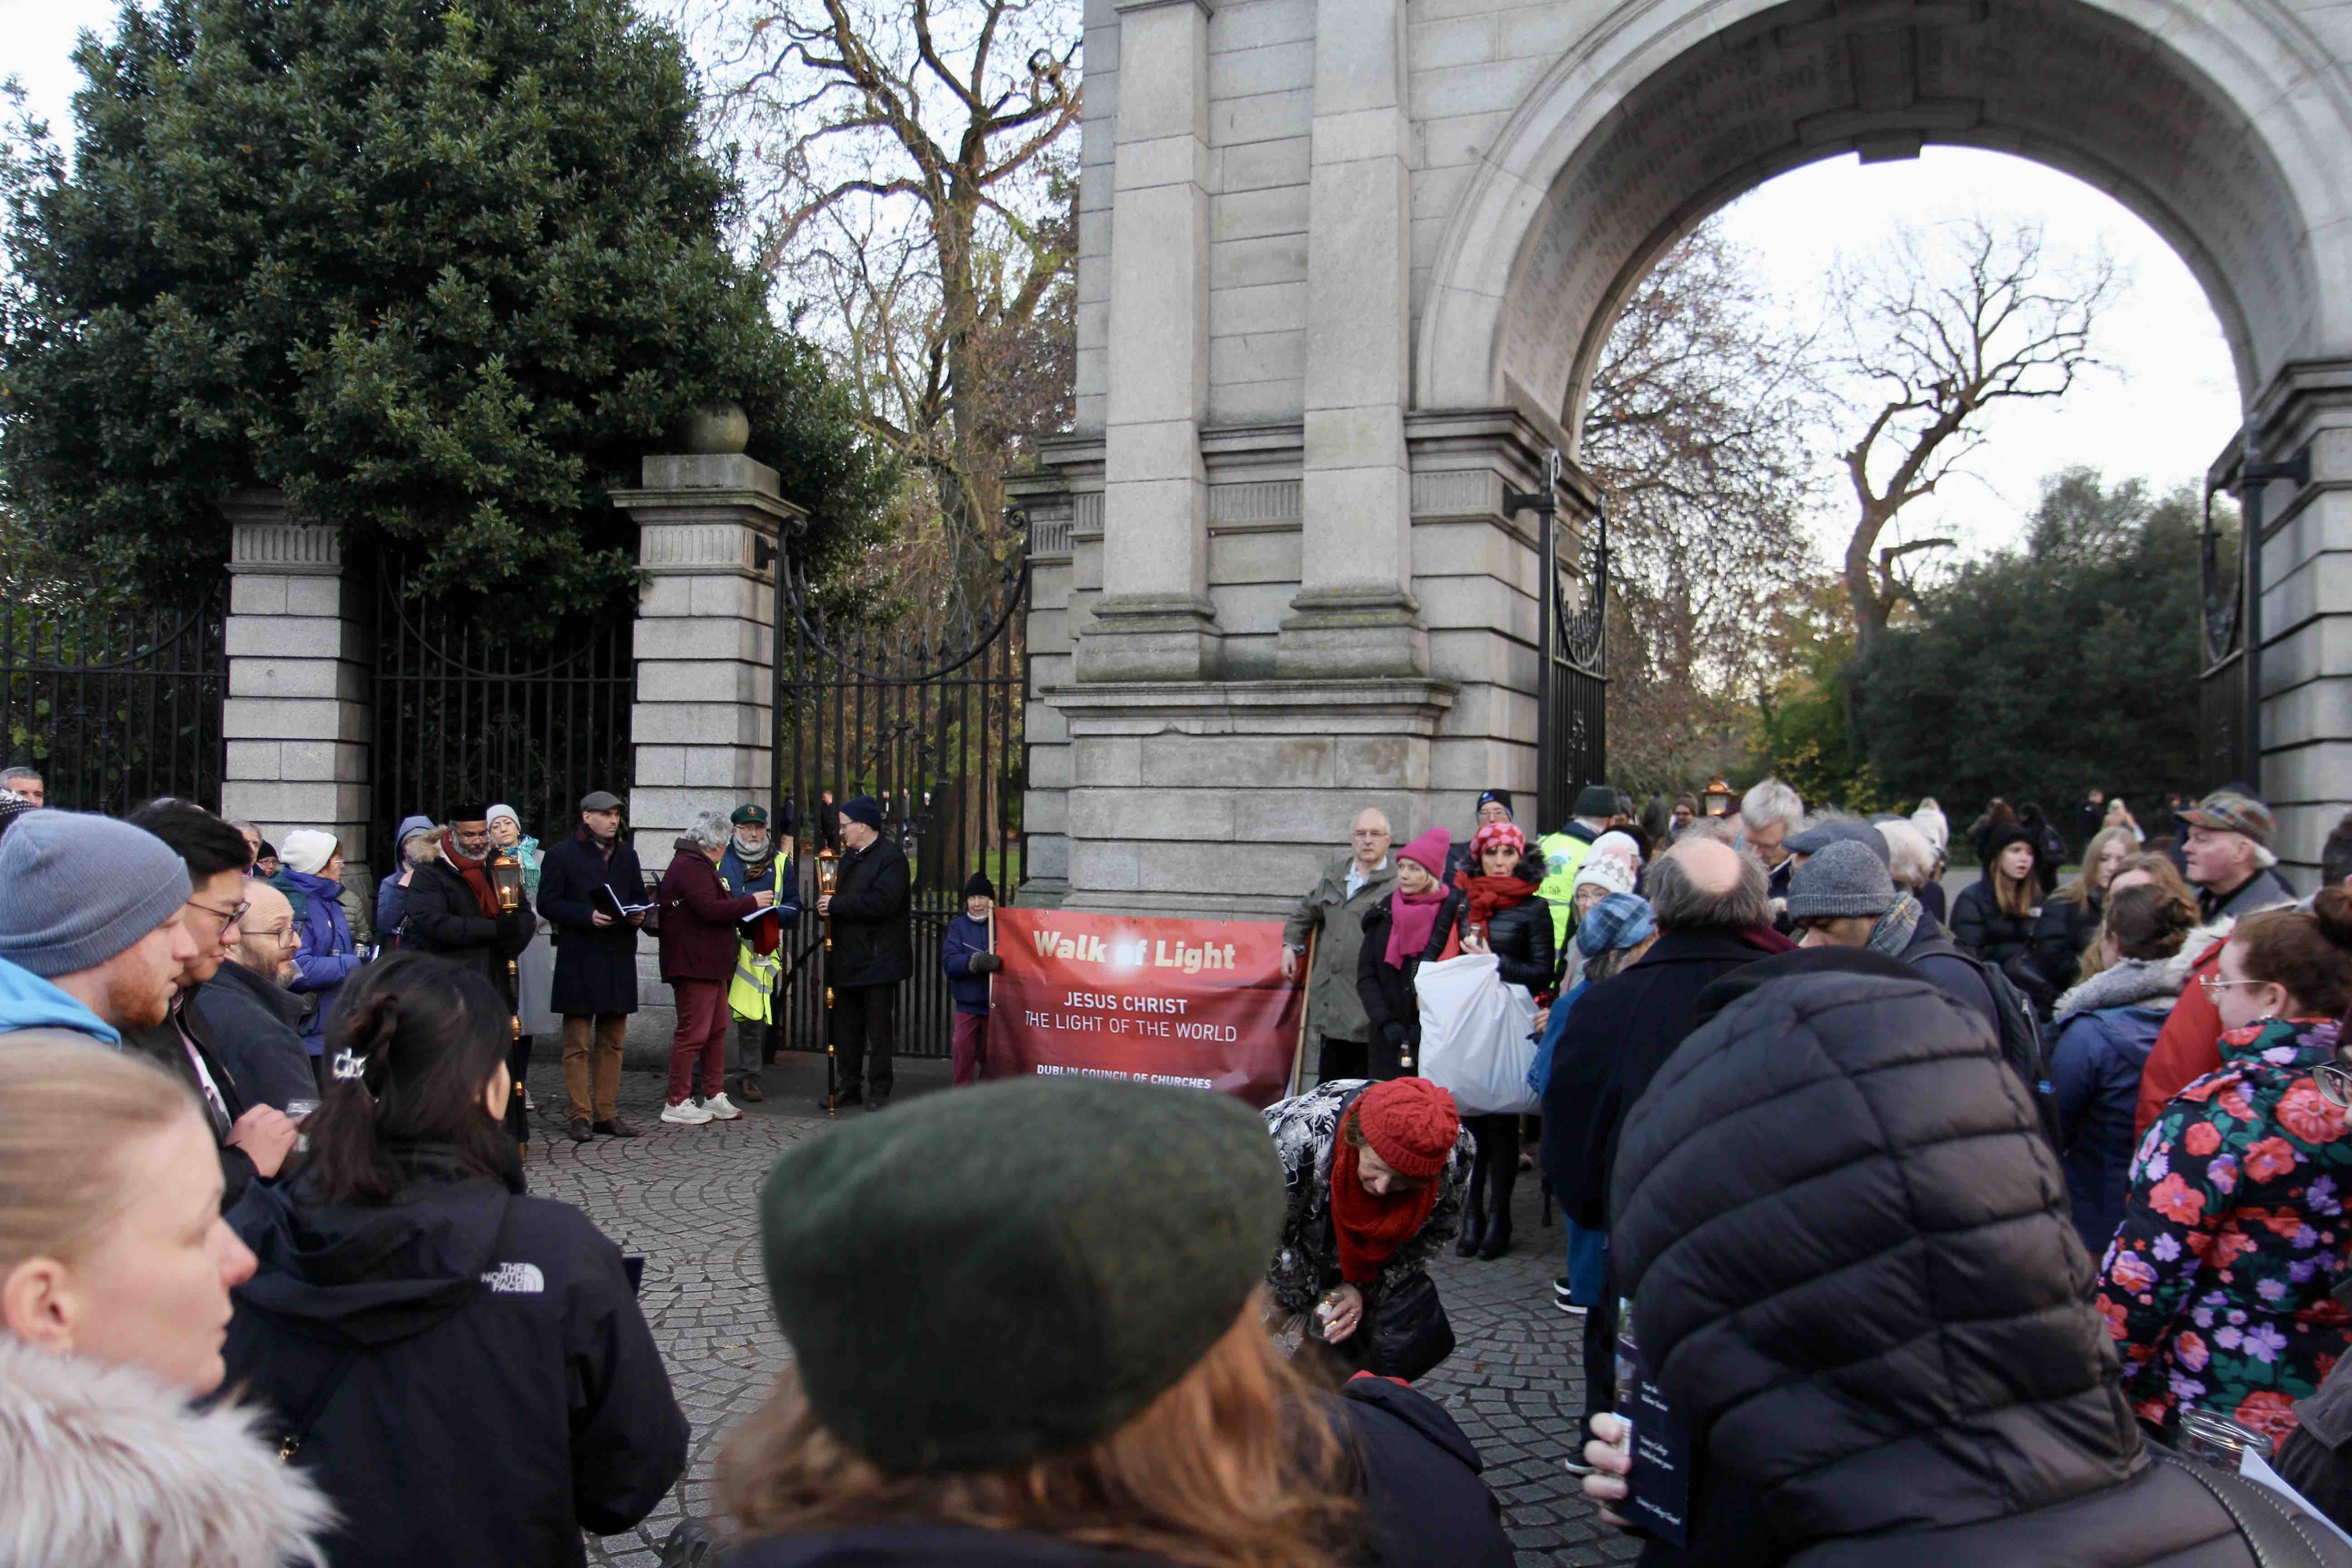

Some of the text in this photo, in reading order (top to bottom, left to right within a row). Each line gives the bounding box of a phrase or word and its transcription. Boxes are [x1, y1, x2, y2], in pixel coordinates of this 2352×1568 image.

[1033, 931, 1236, 975] Walk f Light
[1063, 991, 1188, 1014] JESUS CHRIST
[1025, 1010, 1237, 1042] THE LIGHT OF THE WORLD
[1037, 1064, 1212, 1089] DUBLIN COUNCIL OF CHURCHES
[480, 1272, 524, 1283] NORTH
[500, 1262, 524, 1273] THE
[492, 1282, 524, 1292] FACE
